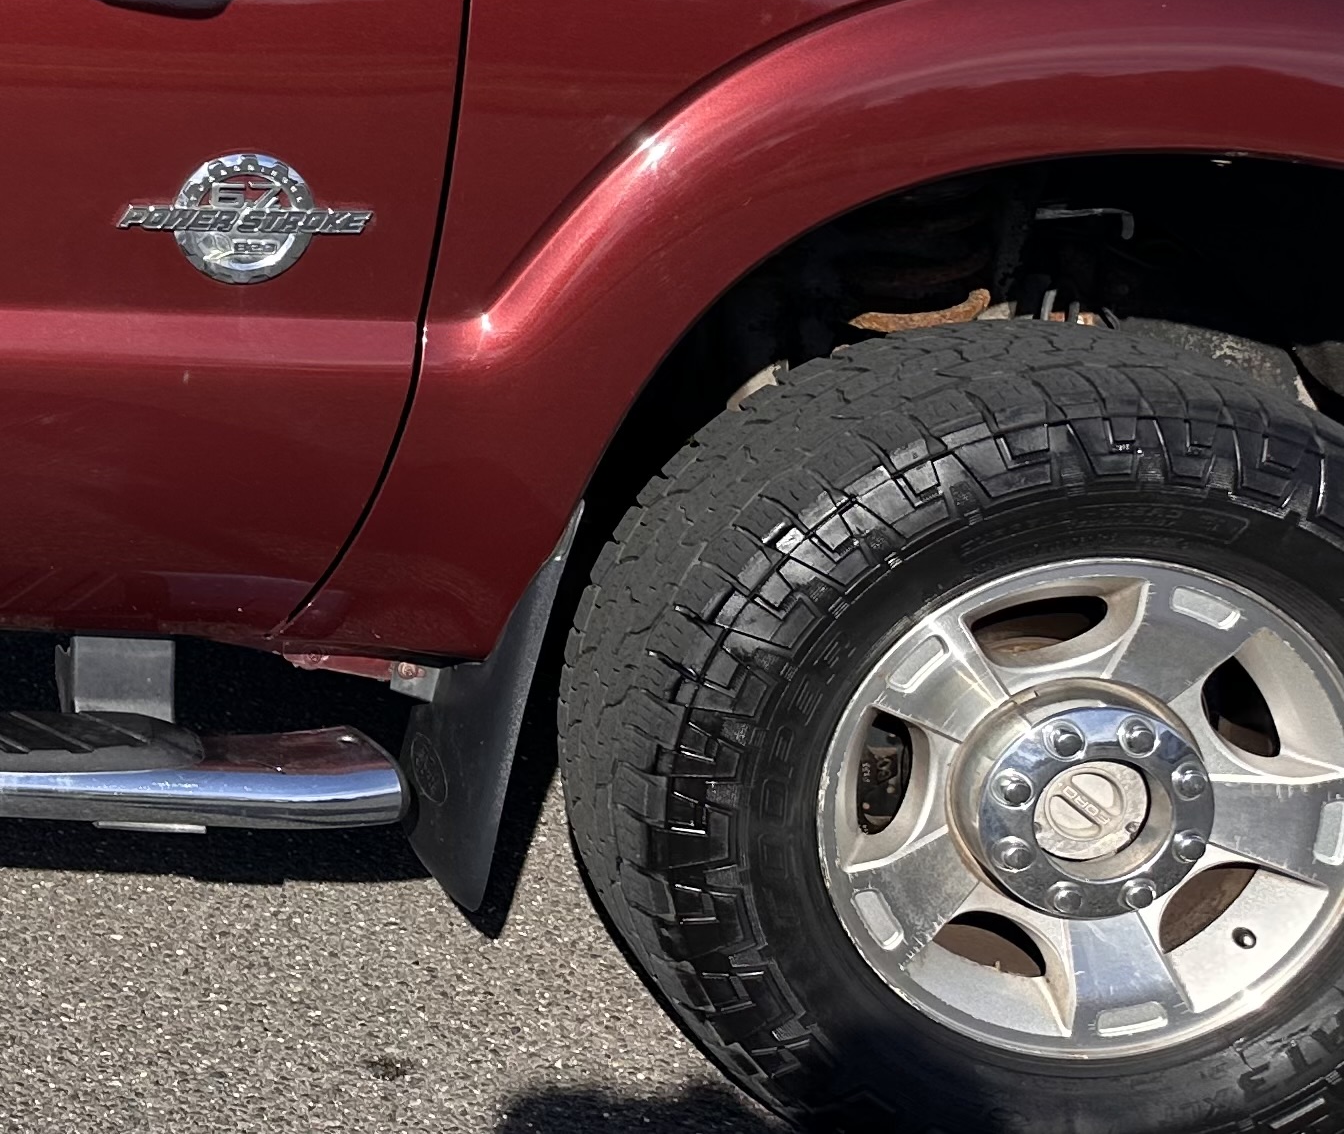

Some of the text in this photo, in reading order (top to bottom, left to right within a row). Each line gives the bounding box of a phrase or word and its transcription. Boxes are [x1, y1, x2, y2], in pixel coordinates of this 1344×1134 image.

[115, 204, 375, 235] POWER STROKE
[1061, 785, 1111, 825] FORD
